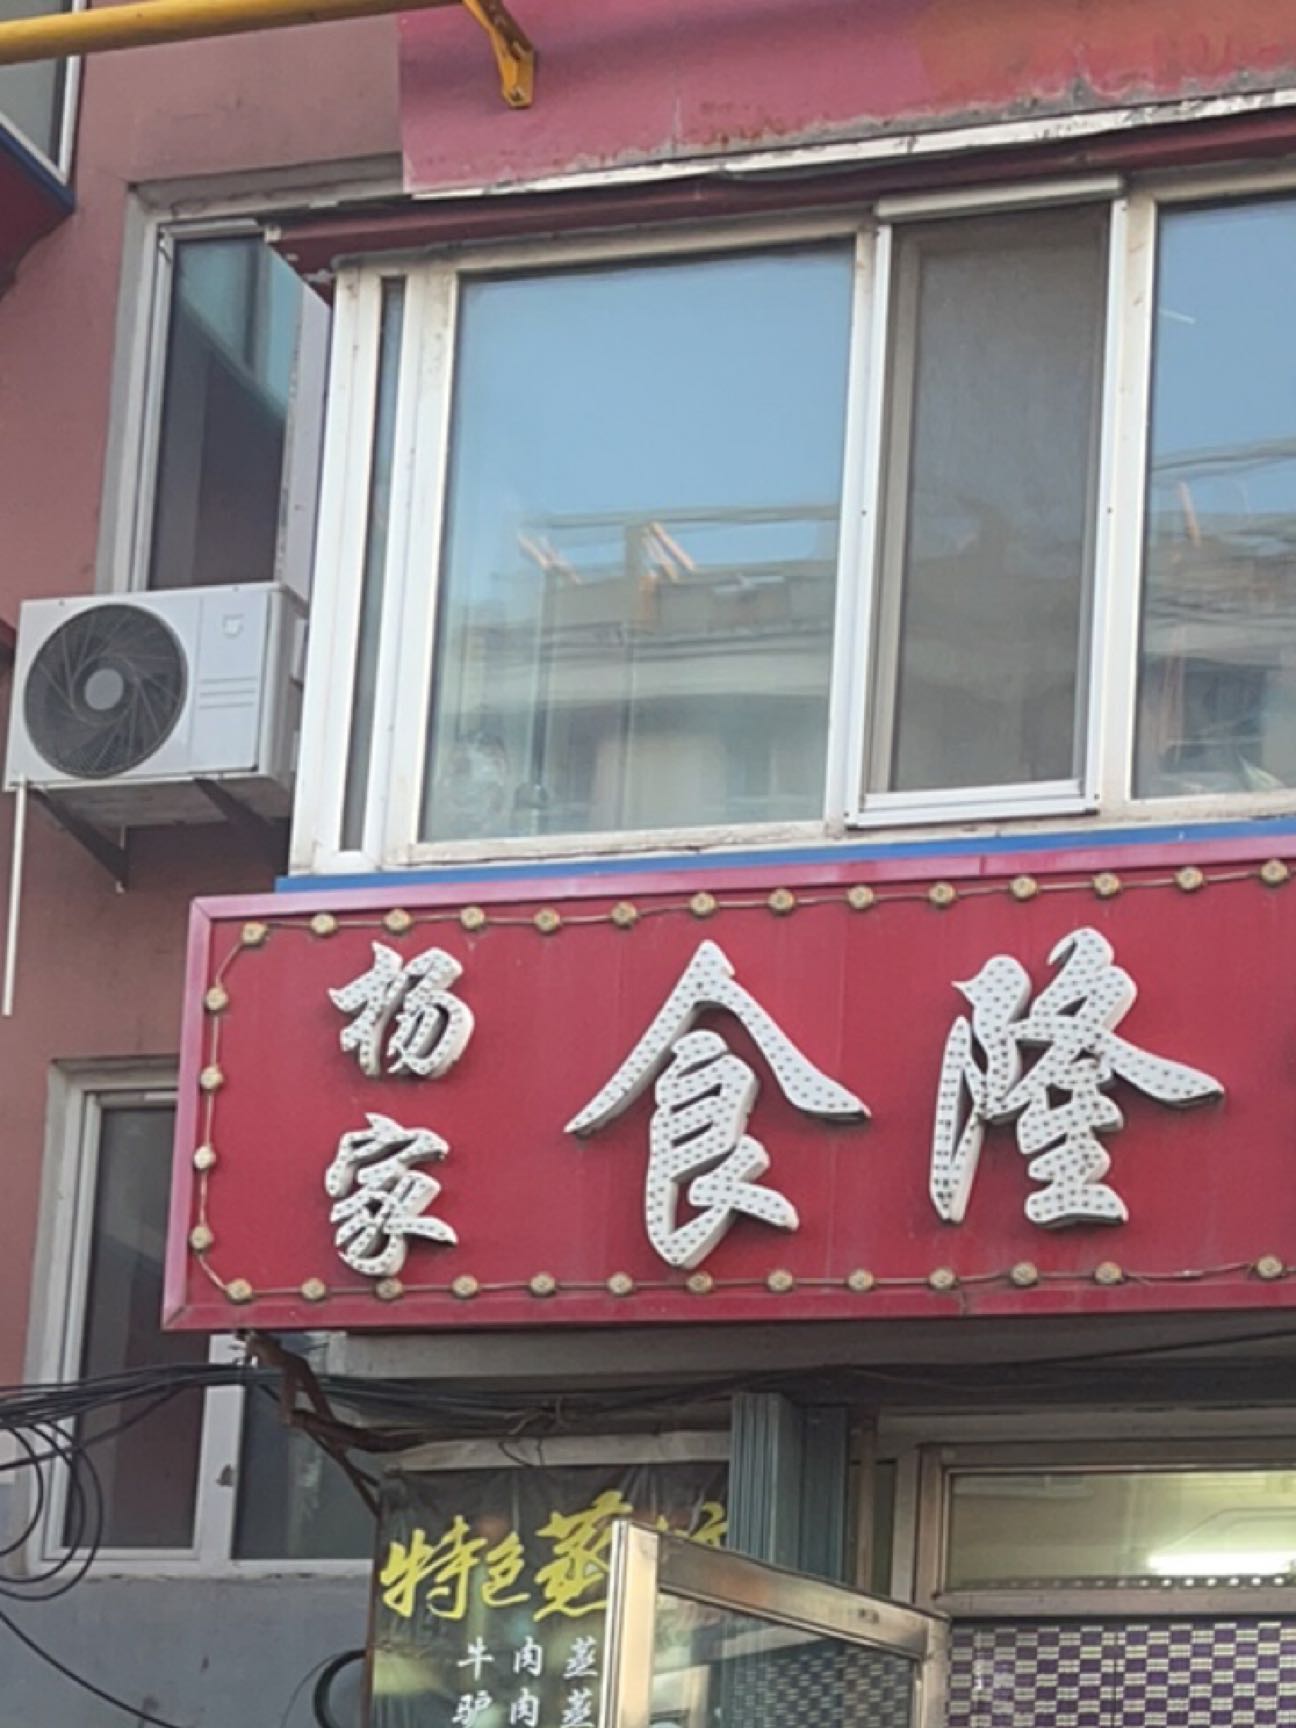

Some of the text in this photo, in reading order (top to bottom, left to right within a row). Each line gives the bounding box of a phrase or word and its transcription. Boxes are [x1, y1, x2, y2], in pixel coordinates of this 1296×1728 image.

[324, 940, 475, 1277] 杨家
[379, 1491, 727, 1622] 特色蒸
